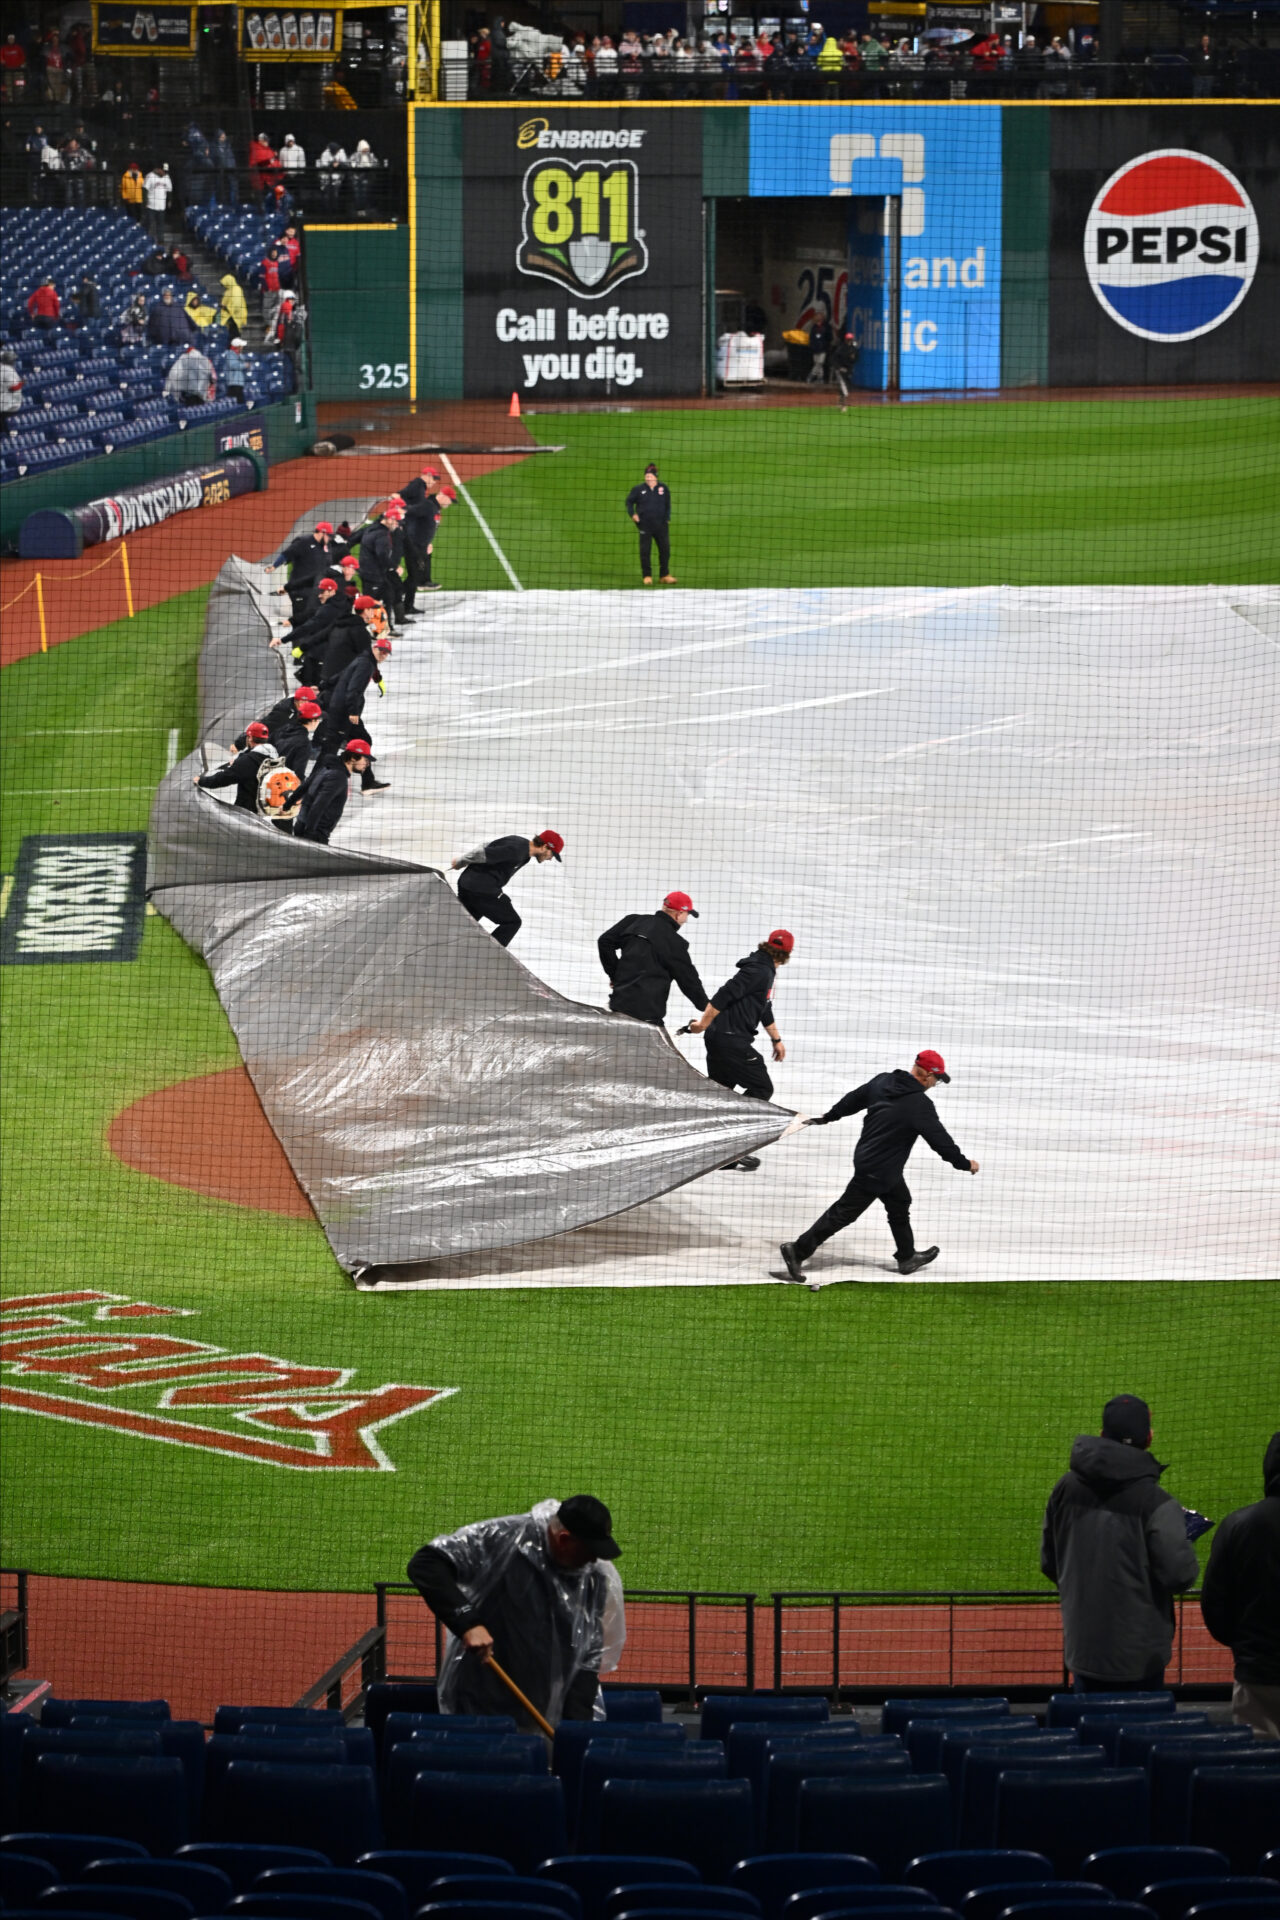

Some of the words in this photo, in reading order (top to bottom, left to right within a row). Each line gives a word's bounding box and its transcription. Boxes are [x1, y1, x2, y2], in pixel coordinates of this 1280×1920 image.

[537, 129, 647, 149] ENBRIDGE
[532, 168, 628, 244] 811
[1097, 226, 1247, 264] PEPSI
[496, 308, 556, 342] Call
[567, 306, 669, 341] before
[359, 363, 409, 389] 325
[522, 353, 580, 387] you
[585, 346, 643, 385] dig.
